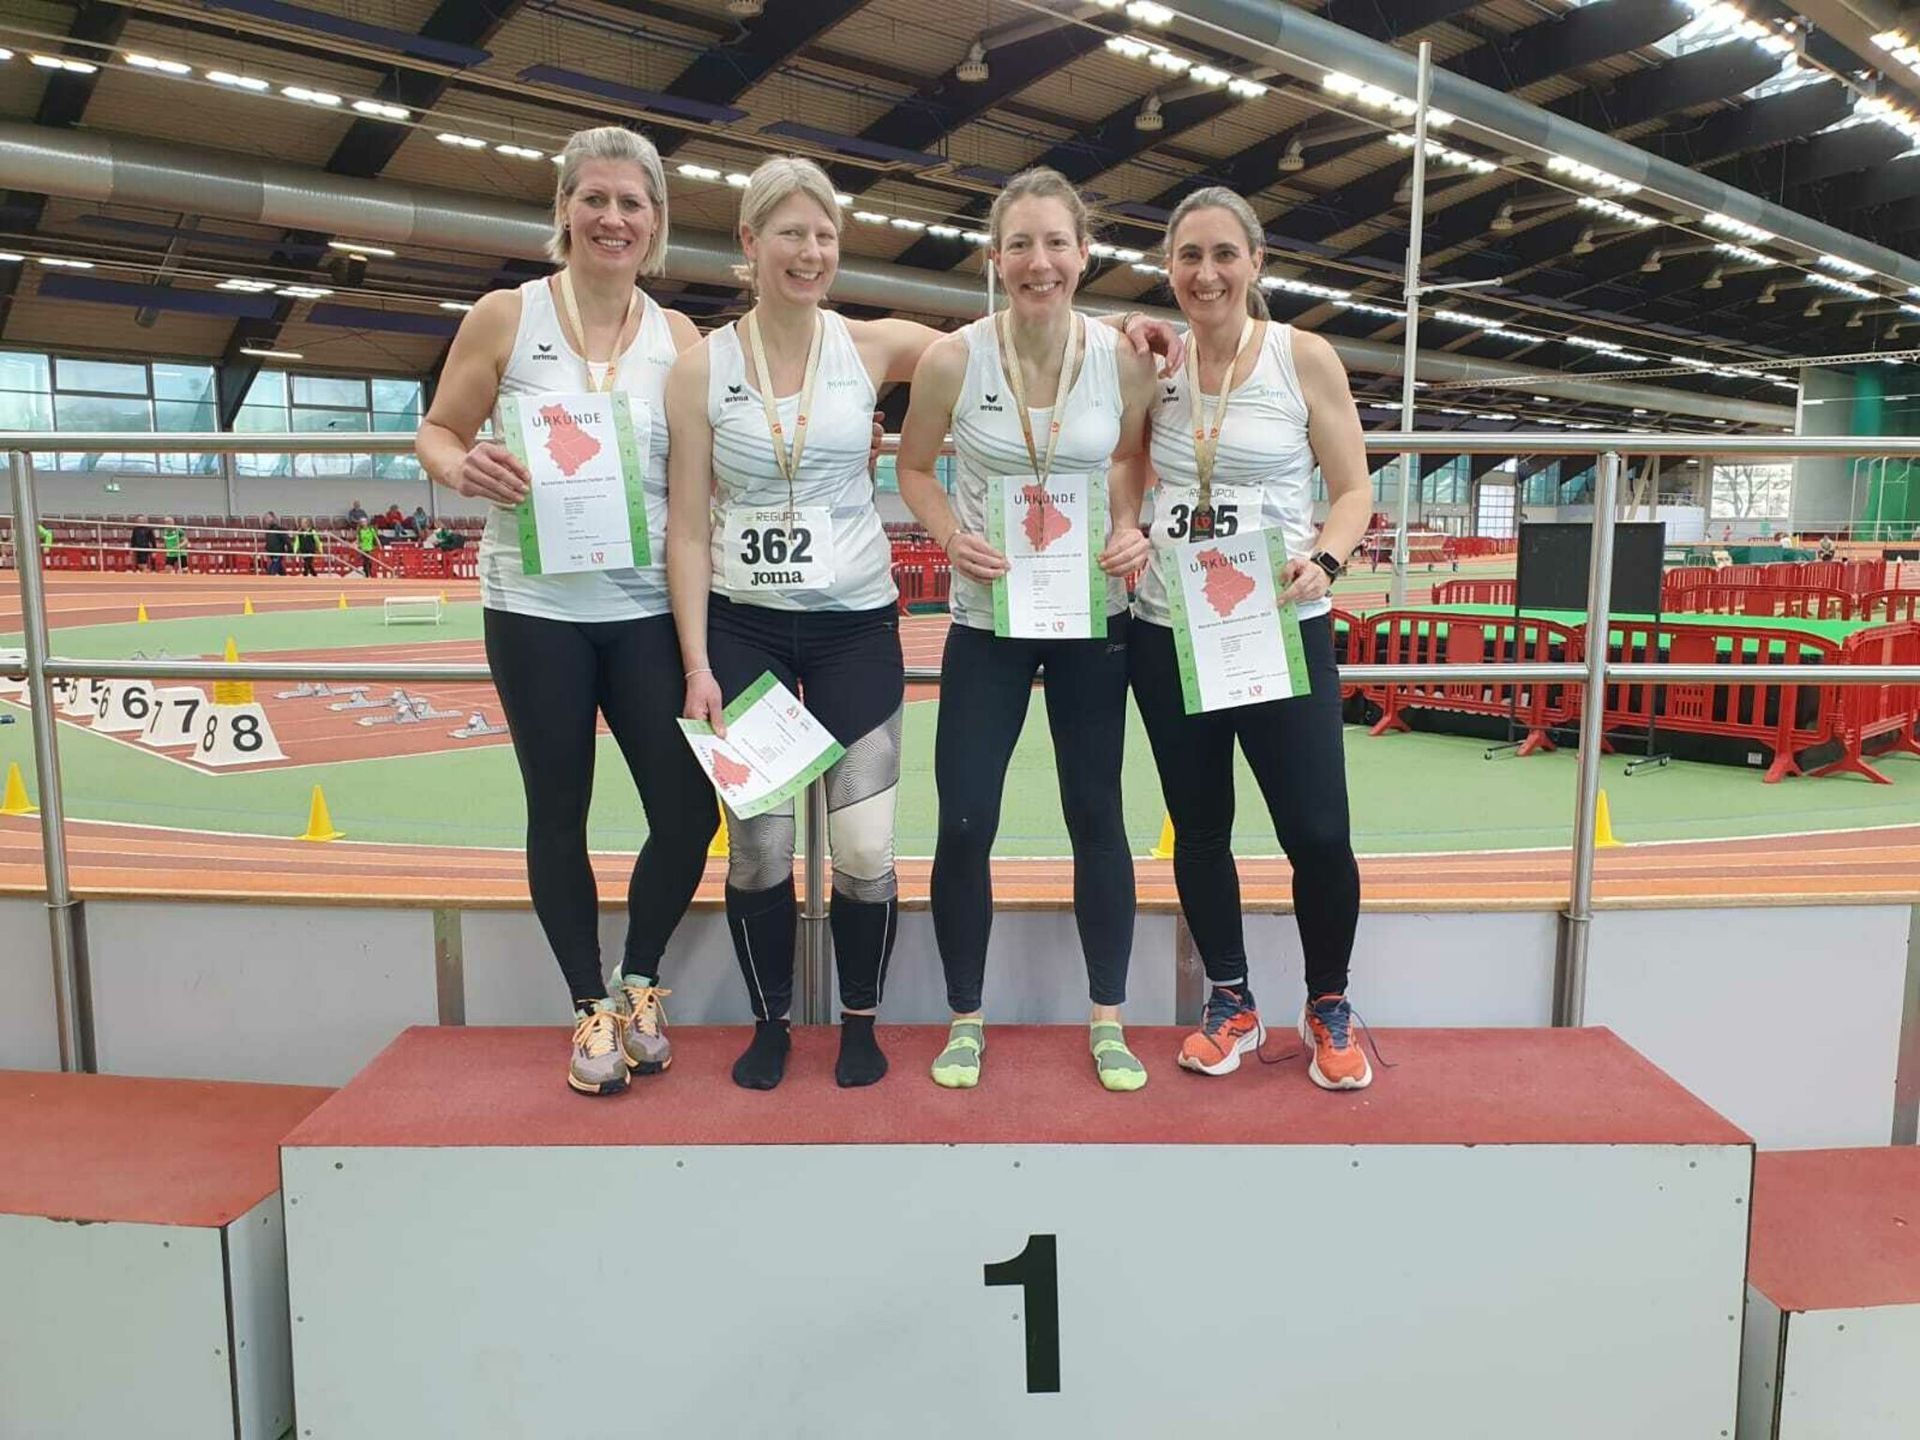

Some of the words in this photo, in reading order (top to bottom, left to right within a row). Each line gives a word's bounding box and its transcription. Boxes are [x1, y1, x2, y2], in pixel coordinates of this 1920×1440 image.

[725, 395, 749, 403] erima
[980, 404, 1003, 412] erima
[532, 412, 602, 428] URKUNDE
[1014, 492, 1077, 505] URKUNDE
[1167, 503, 1238, 539] 35
[740, 527, 813, 565] 362
[1189, 550, 1257, 573] URKUNDE
[100, 687, 111, 719] 6
[122, 686, 149, 719] 6
[150, 701, 163, 734] 7
[173, 699, 200, 733] 7
[203, 715, 218, 752] 8
[231, 714, 263, 752] 8
[984, 1234, 1060, 1393] 1
